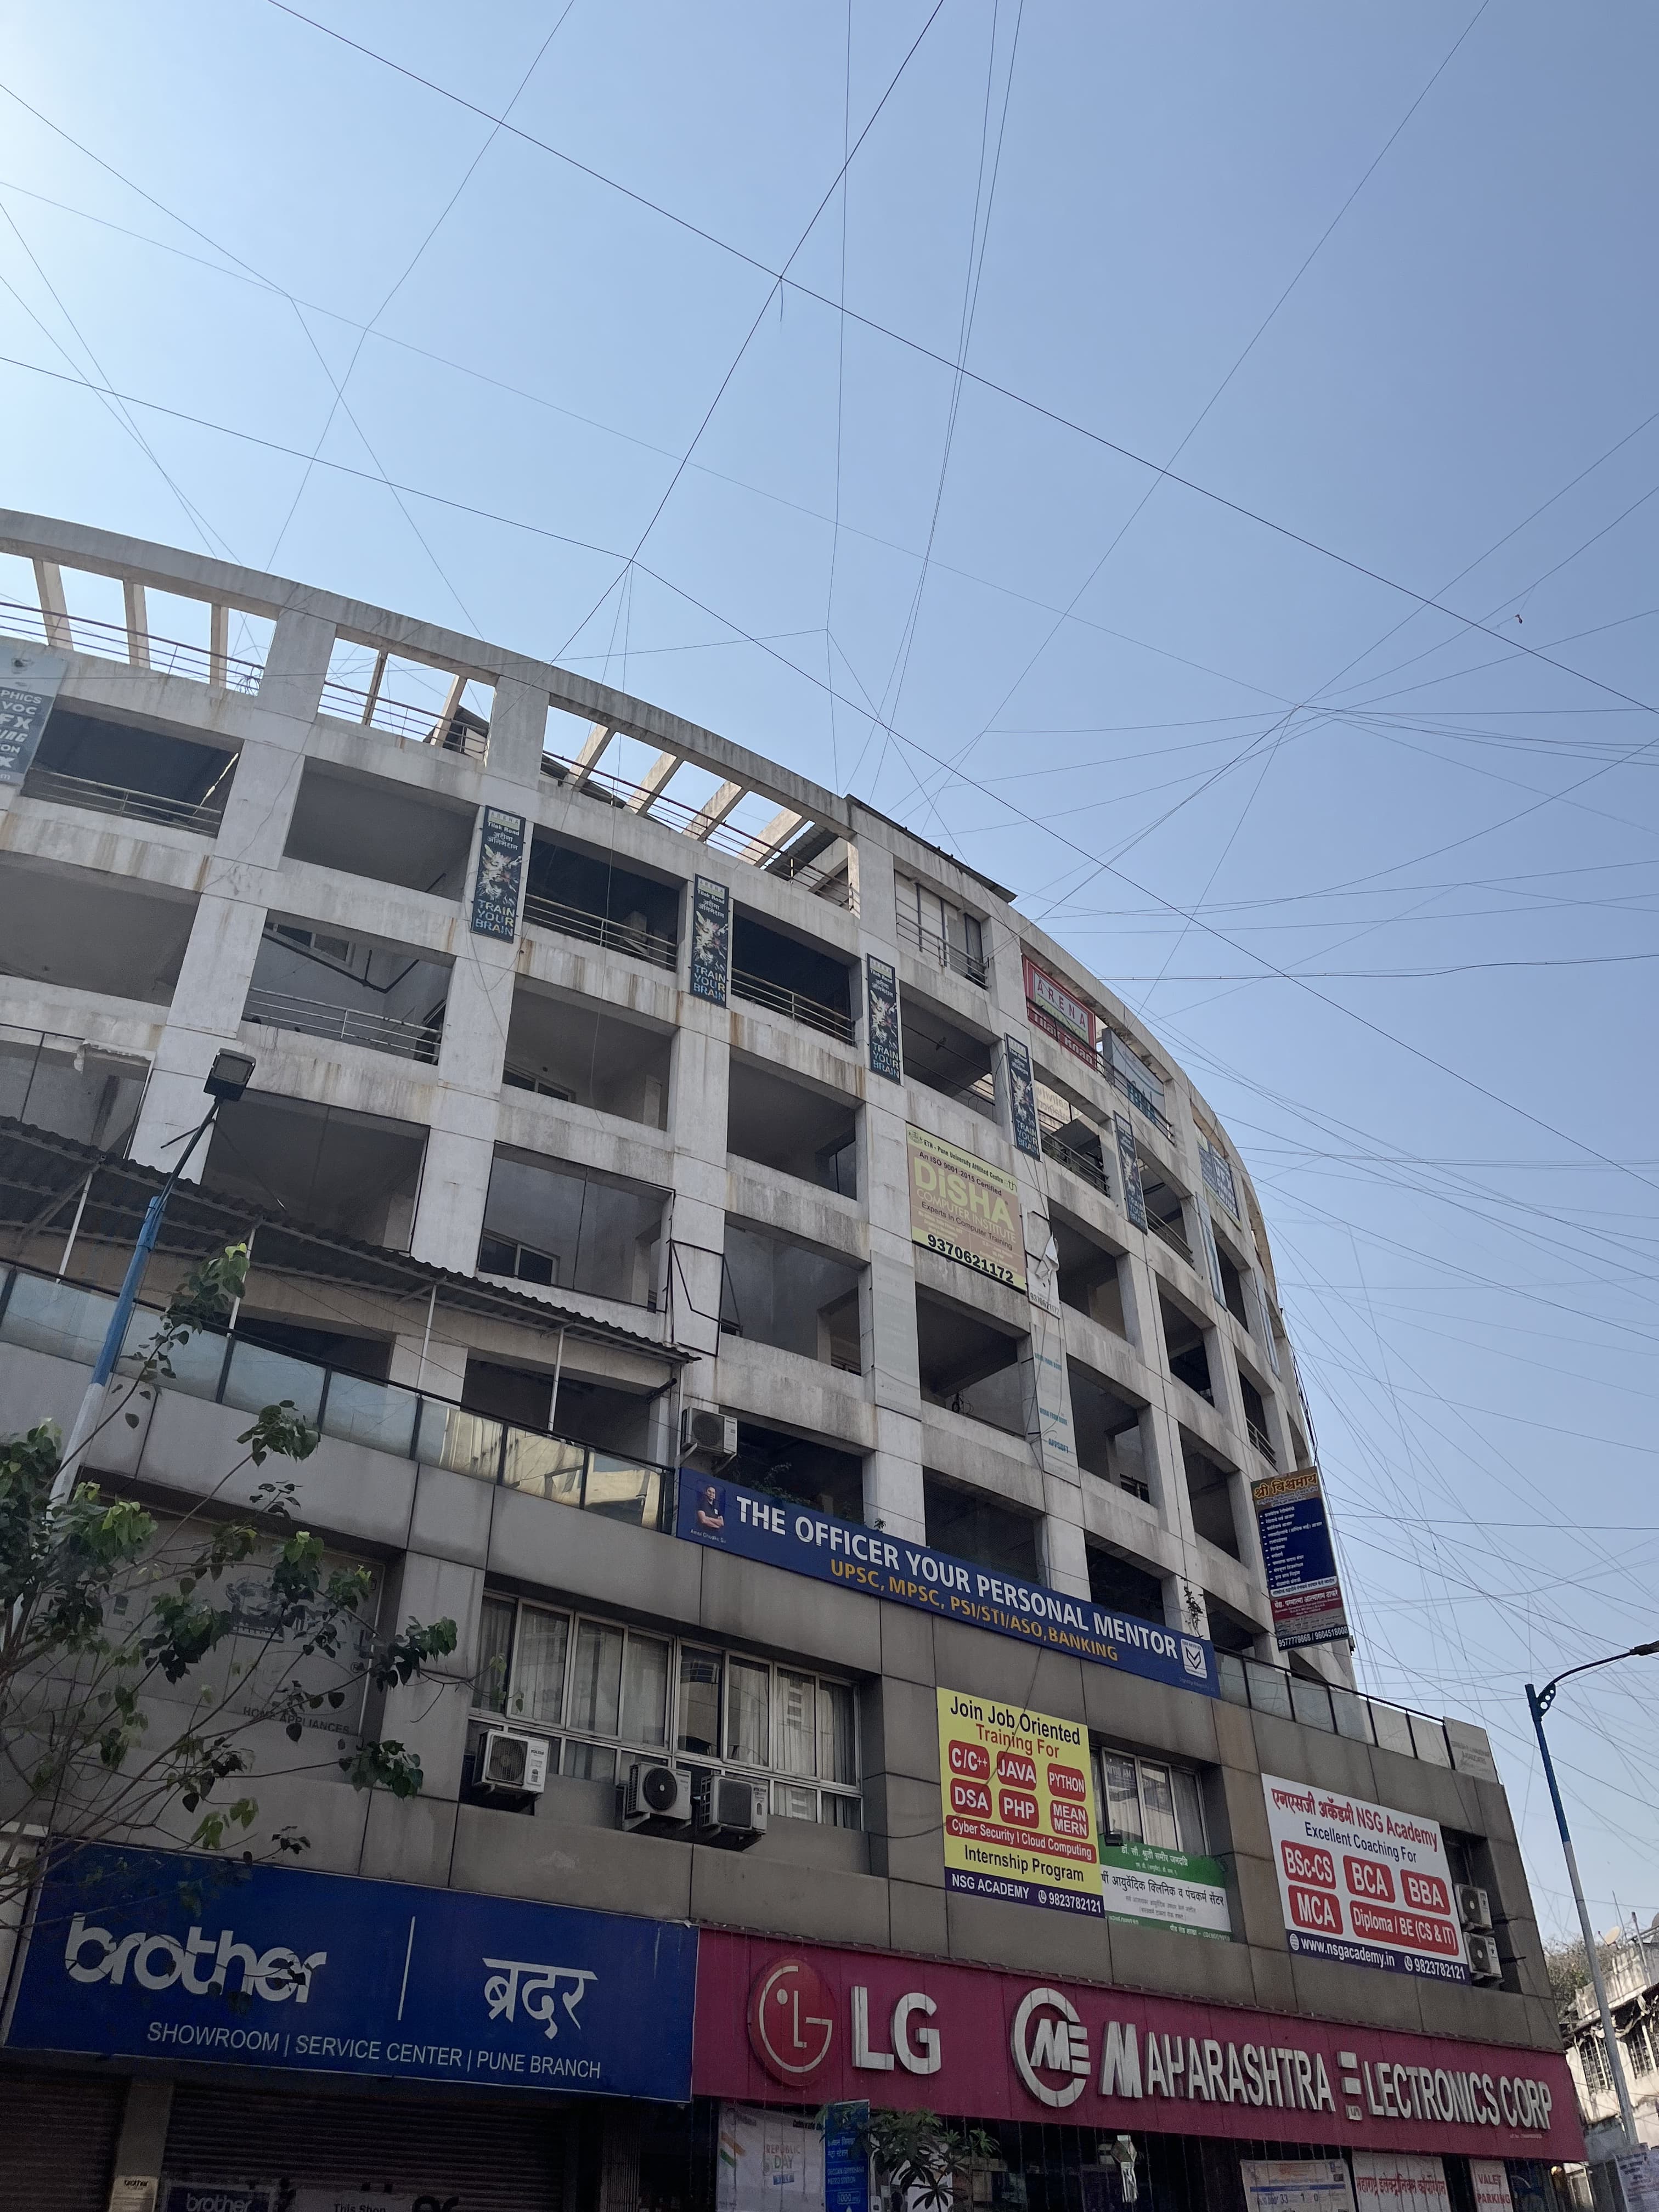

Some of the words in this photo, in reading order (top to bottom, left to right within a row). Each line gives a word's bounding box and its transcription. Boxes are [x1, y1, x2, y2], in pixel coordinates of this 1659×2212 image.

[490, 812, 520, 825] ARENA
[477, 899, 515, 918] TRAIN
[477, 909, 514, 927] YOUR
[476, 918, 513, 936] BRAIN
[695, 964, 726, 984] TRAIN
[695, 973, 725, 993] YOUR
[693, 984, 725, 1002] BRAIN
[1037, 979, 1086, 1028] ARENA
[872, 1042, 899, 1060] TRAIN
[873, 1051, 899, 1070] YOUR
[873, 1059, 899, 1079] BRAIN
[1016, 1120, 1037, 1137] TRAIN
[1018, 1129, 1038, 1146] YOUR
[1018, 1138, 1039, 1156] BRAIN
[919, 1152, 929, 1160] An
[930, 1157, 942, 1166] ISO
[977, 1178, 1002, 1196] Certified
[917, 1188, 970, 1221] COMPUTER
[972, 1215, 1016, 1243] INSTITUTE
[922, 1201, 946, 1218] Experts
[956, 1217, 986, 1235] Computer
[988, 1233, 1013, 1251] Training
[927, 1234, 1014, 1284] 9370621172
[1254, 1482, 1269, 1498] श्री
[736, 1496, 786, 1536] THE
[794, 1516, 900, 1571] OFFICER
[905, 1550, 970, 1594] YOUR
[976, 1574, 1090, 1632] PERSONAL
[1093, 1612, 1178, 1660] MENTOR
[831, 1559, 884, 1591] UPSC,
[889, 1576, 945, 1610] MPSC,
[950, 1696, 983, 1722] Join
[988, 1706, 1015, 1729] Job
[1019, 1713, 1080, 1746] Oriented
[975, 1723, 1032, 1756] Training
[1037, 1739, 1060, 1758] For
[951, 1747, 988, 1771] C/C++
[997, 1759, 1036, 1784] JAVA
[1049, 1771, 1085, 1794] PYTHON
[954, 1786, 989, 1811] DSA
[1003, 1797, 1035, 1820] PHP
[1053, 1803, 1086, 1822] MEAN
[952, 1818, 978, 1836] Cyber
[979, 1824, 1014, 1845] Security
[1022, 1832, 1046, 1848] Cloud
[1048, 1840, 1092, 1861] Computing
[1054, 1820, 1087, 1836] MERN
[1356, 1806, 1383, 1833] NSG
[1387, 1815, 1437, 1852] Academy
[1305, 1821, 1352, 1847] Excellent
[1354, 1835, 1400, 1862] Coaching
[1401, 1846, 1417, 1863] For
[964, 1844, 1028, 1874] Internship
[1032, 1858, 1084, 1882] Program
[1285, 1847, 1333, 1883] BSc-CS
[952, 1874, 975, 1890] NSG
[978, 1878, 1029, 1899] ACADEMY
[1049, 1893, 1101, 1913] 9823782121
[1112, 1874, 1146, 1892] आयुर्वेदिक
[1148, 1879, 1175, 1897] क्लिनिक
[1178, 1888, 1183, 1898] व
[1185, 1886, 1207, 1903] पंचकर्म
[1351, 1863, 1389, 1897] BCA
[1408, 1876, 1444, 1908] BBA
[1297, 1892, 1336, 1927] MCA
[1353, 1907, 1393, 1933] Diploma
[1400, 1917, 1414, 1937] BE
[1415, 1920, 1432, 1942] (CS
[1434, 1926, 1441, 1943] &
[1442, 1928, 1457, 1950] IT)
[65, 1912, 327, 2003] brother
[1301, 1937, 1395, 1967] www.nsgacademy.in
[1414, 1958, 1466, 1981] 9823782121
[482, 1957, 598, 2039] ब्रदर
[850, 1985, 942, 2075] LG
[147, 2022, 279, 2052] SHOWROOM
[295, 2034, 381, 2060] SERVICE
[387, 2042, 462, 2067] CENTER
[477, 2050, 525, 2072] PUNE
[530, 2055, 601, 2079] BRANCH
[1500, 2075, 1553, 2130] CORP
[774, 2155, 794, 2169] DAY
[124, 2179, 149, 2187] brother
[1477, 2174, 1502, 2186] VALET
[187, 2193, 253, 2212] brother
[1477, 2194, 1510, 2204] PARKING
